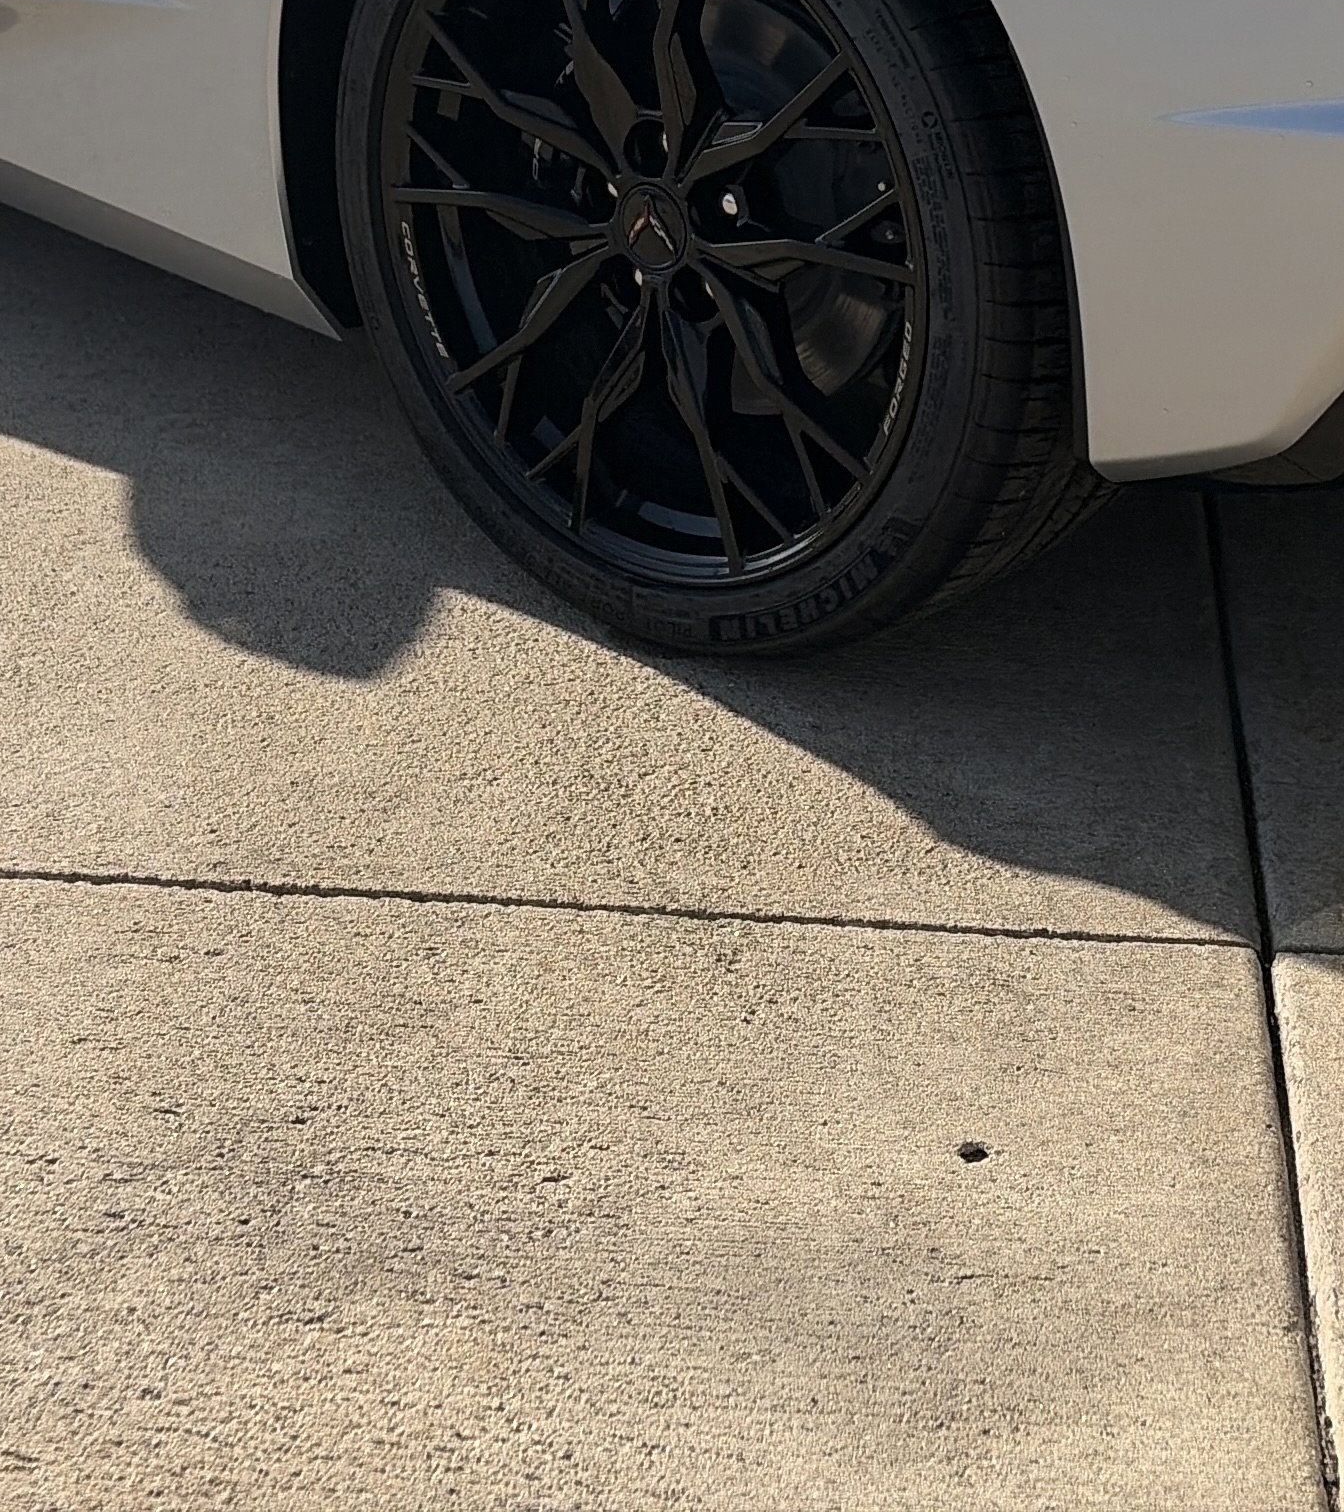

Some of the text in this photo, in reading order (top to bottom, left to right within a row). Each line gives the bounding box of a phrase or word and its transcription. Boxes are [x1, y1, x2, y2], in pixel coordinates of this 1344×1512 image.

[401, 221, 450, 358] CORVETTE
[883, 321, 912, 436] FORGED
[719, 553, 879, 640] MICHELIN
